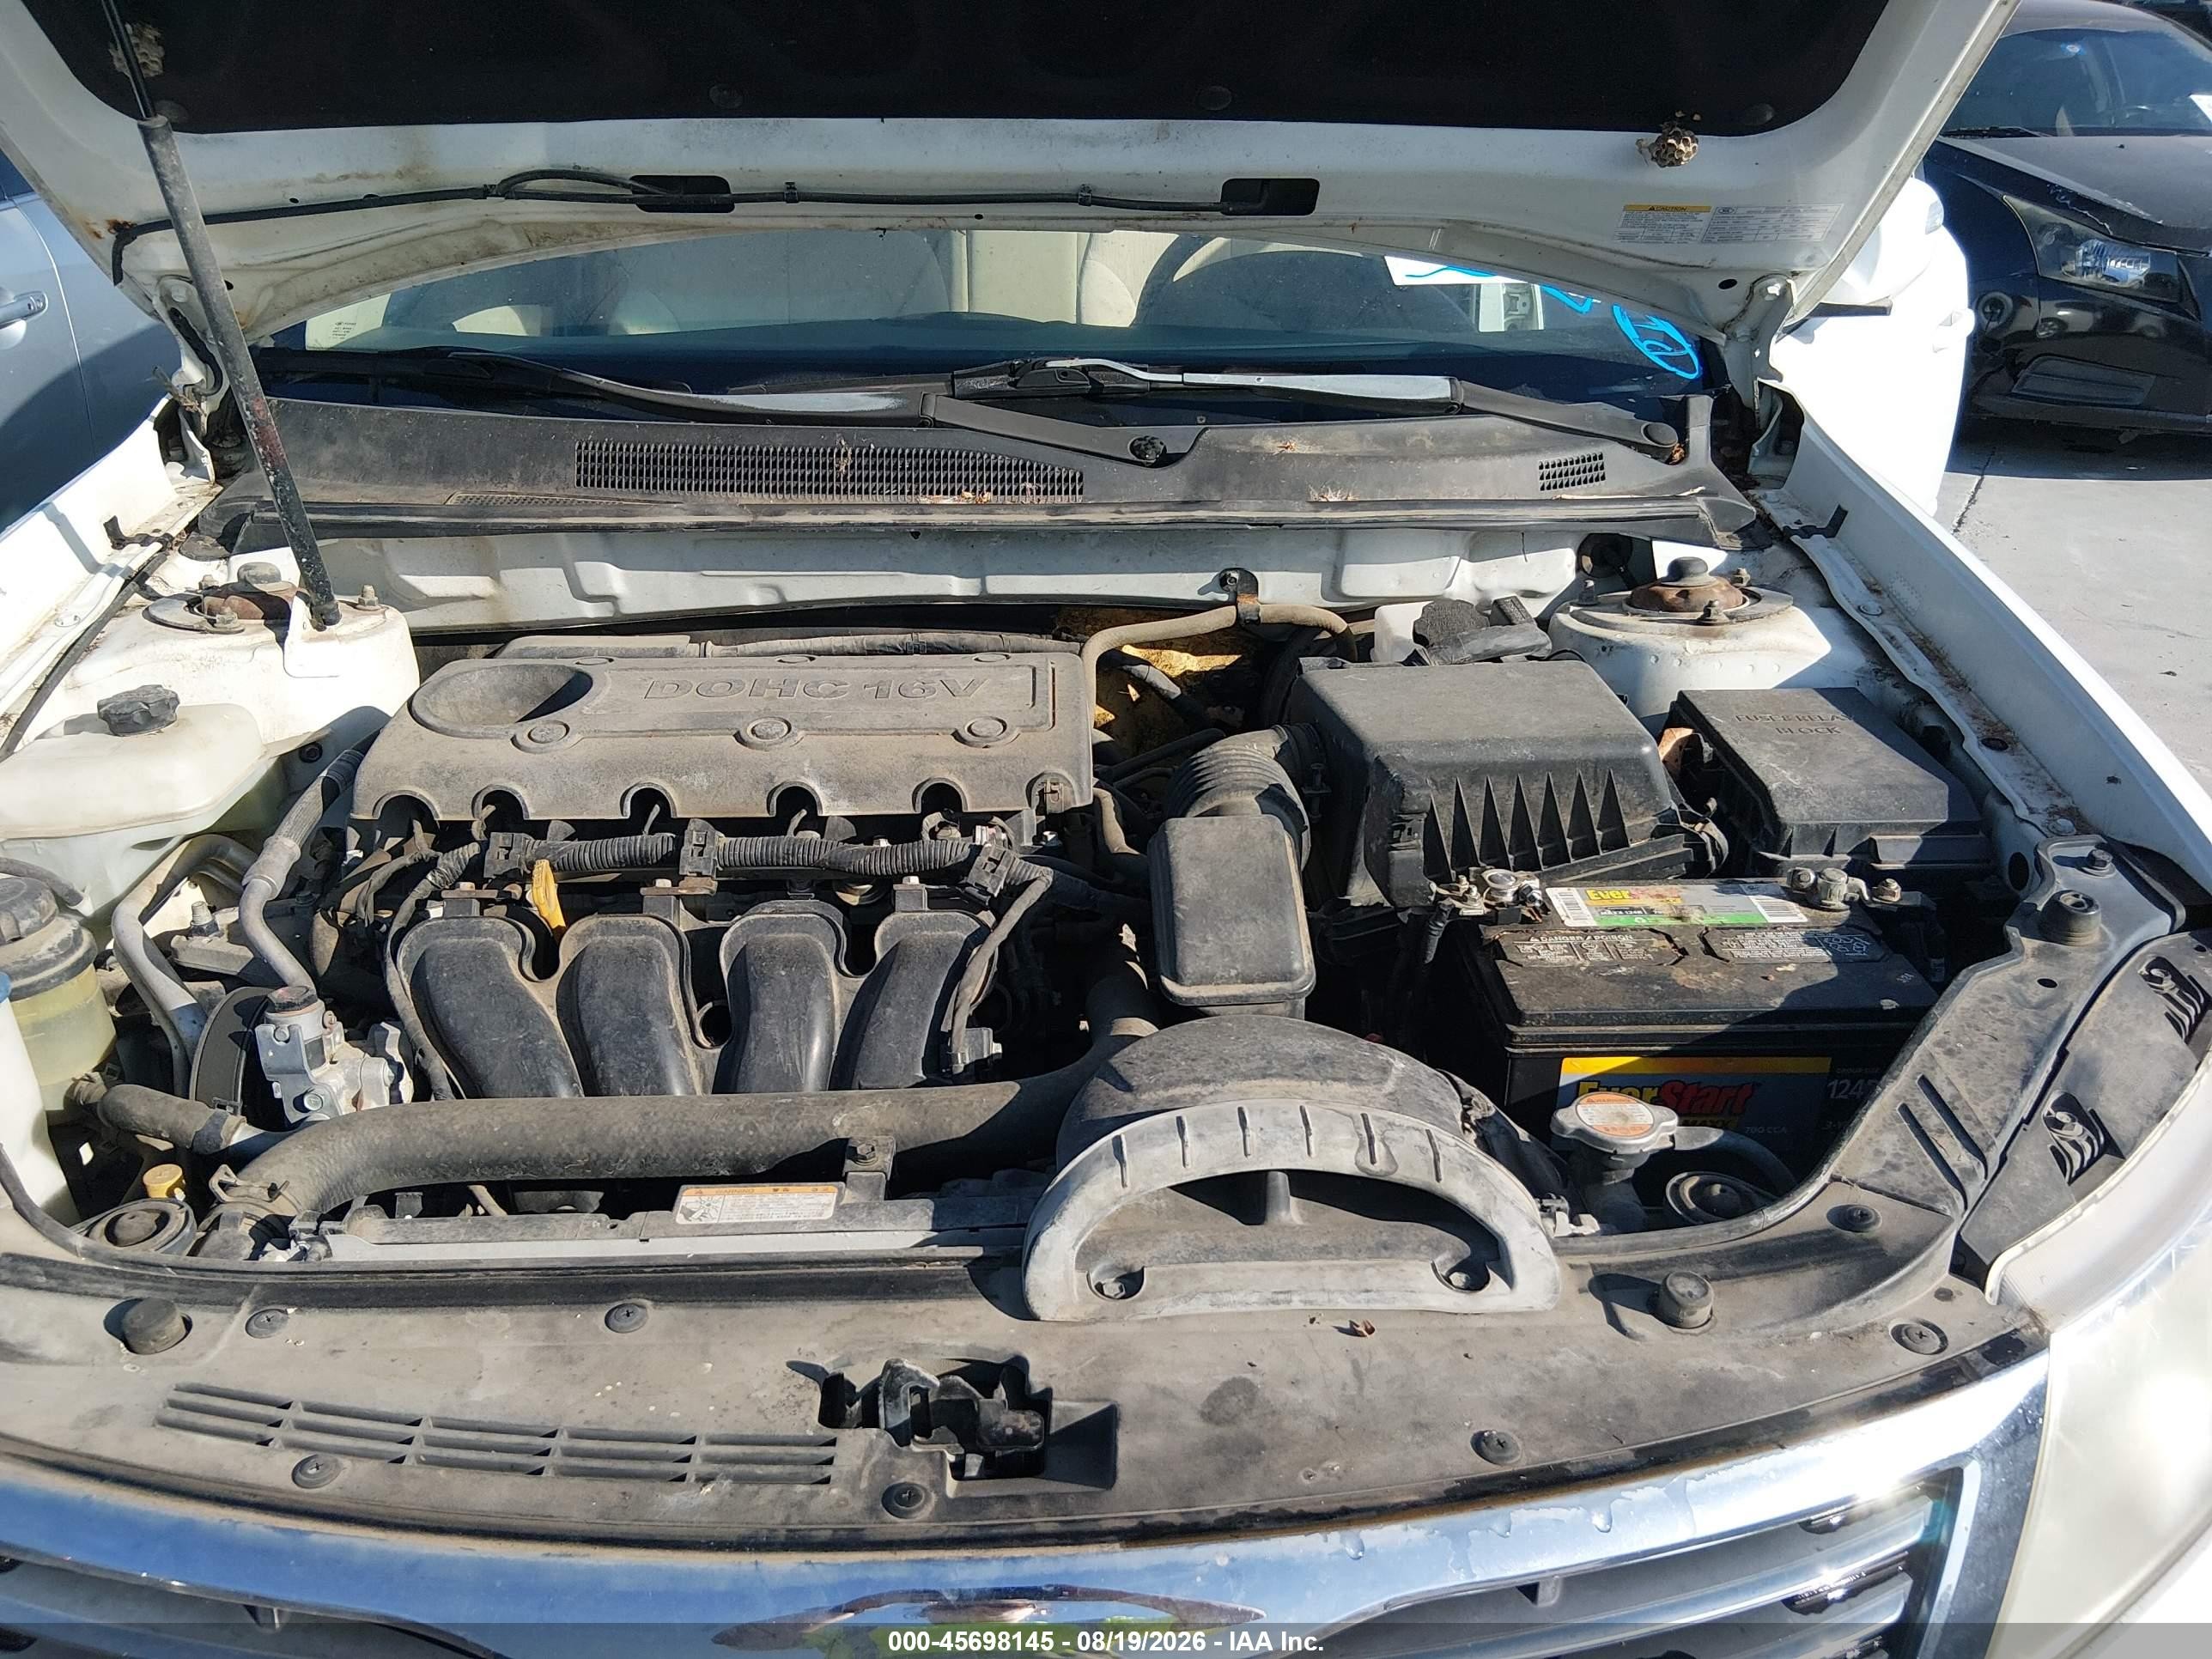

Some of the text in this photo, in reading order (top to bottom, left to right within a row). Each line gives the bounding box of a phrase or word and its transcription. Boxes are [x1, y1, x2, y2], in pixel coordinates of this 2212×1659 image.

[643, 678, 991, 700] DOHC 16V
[1577, 1080, 1754, 1115] EerStart
